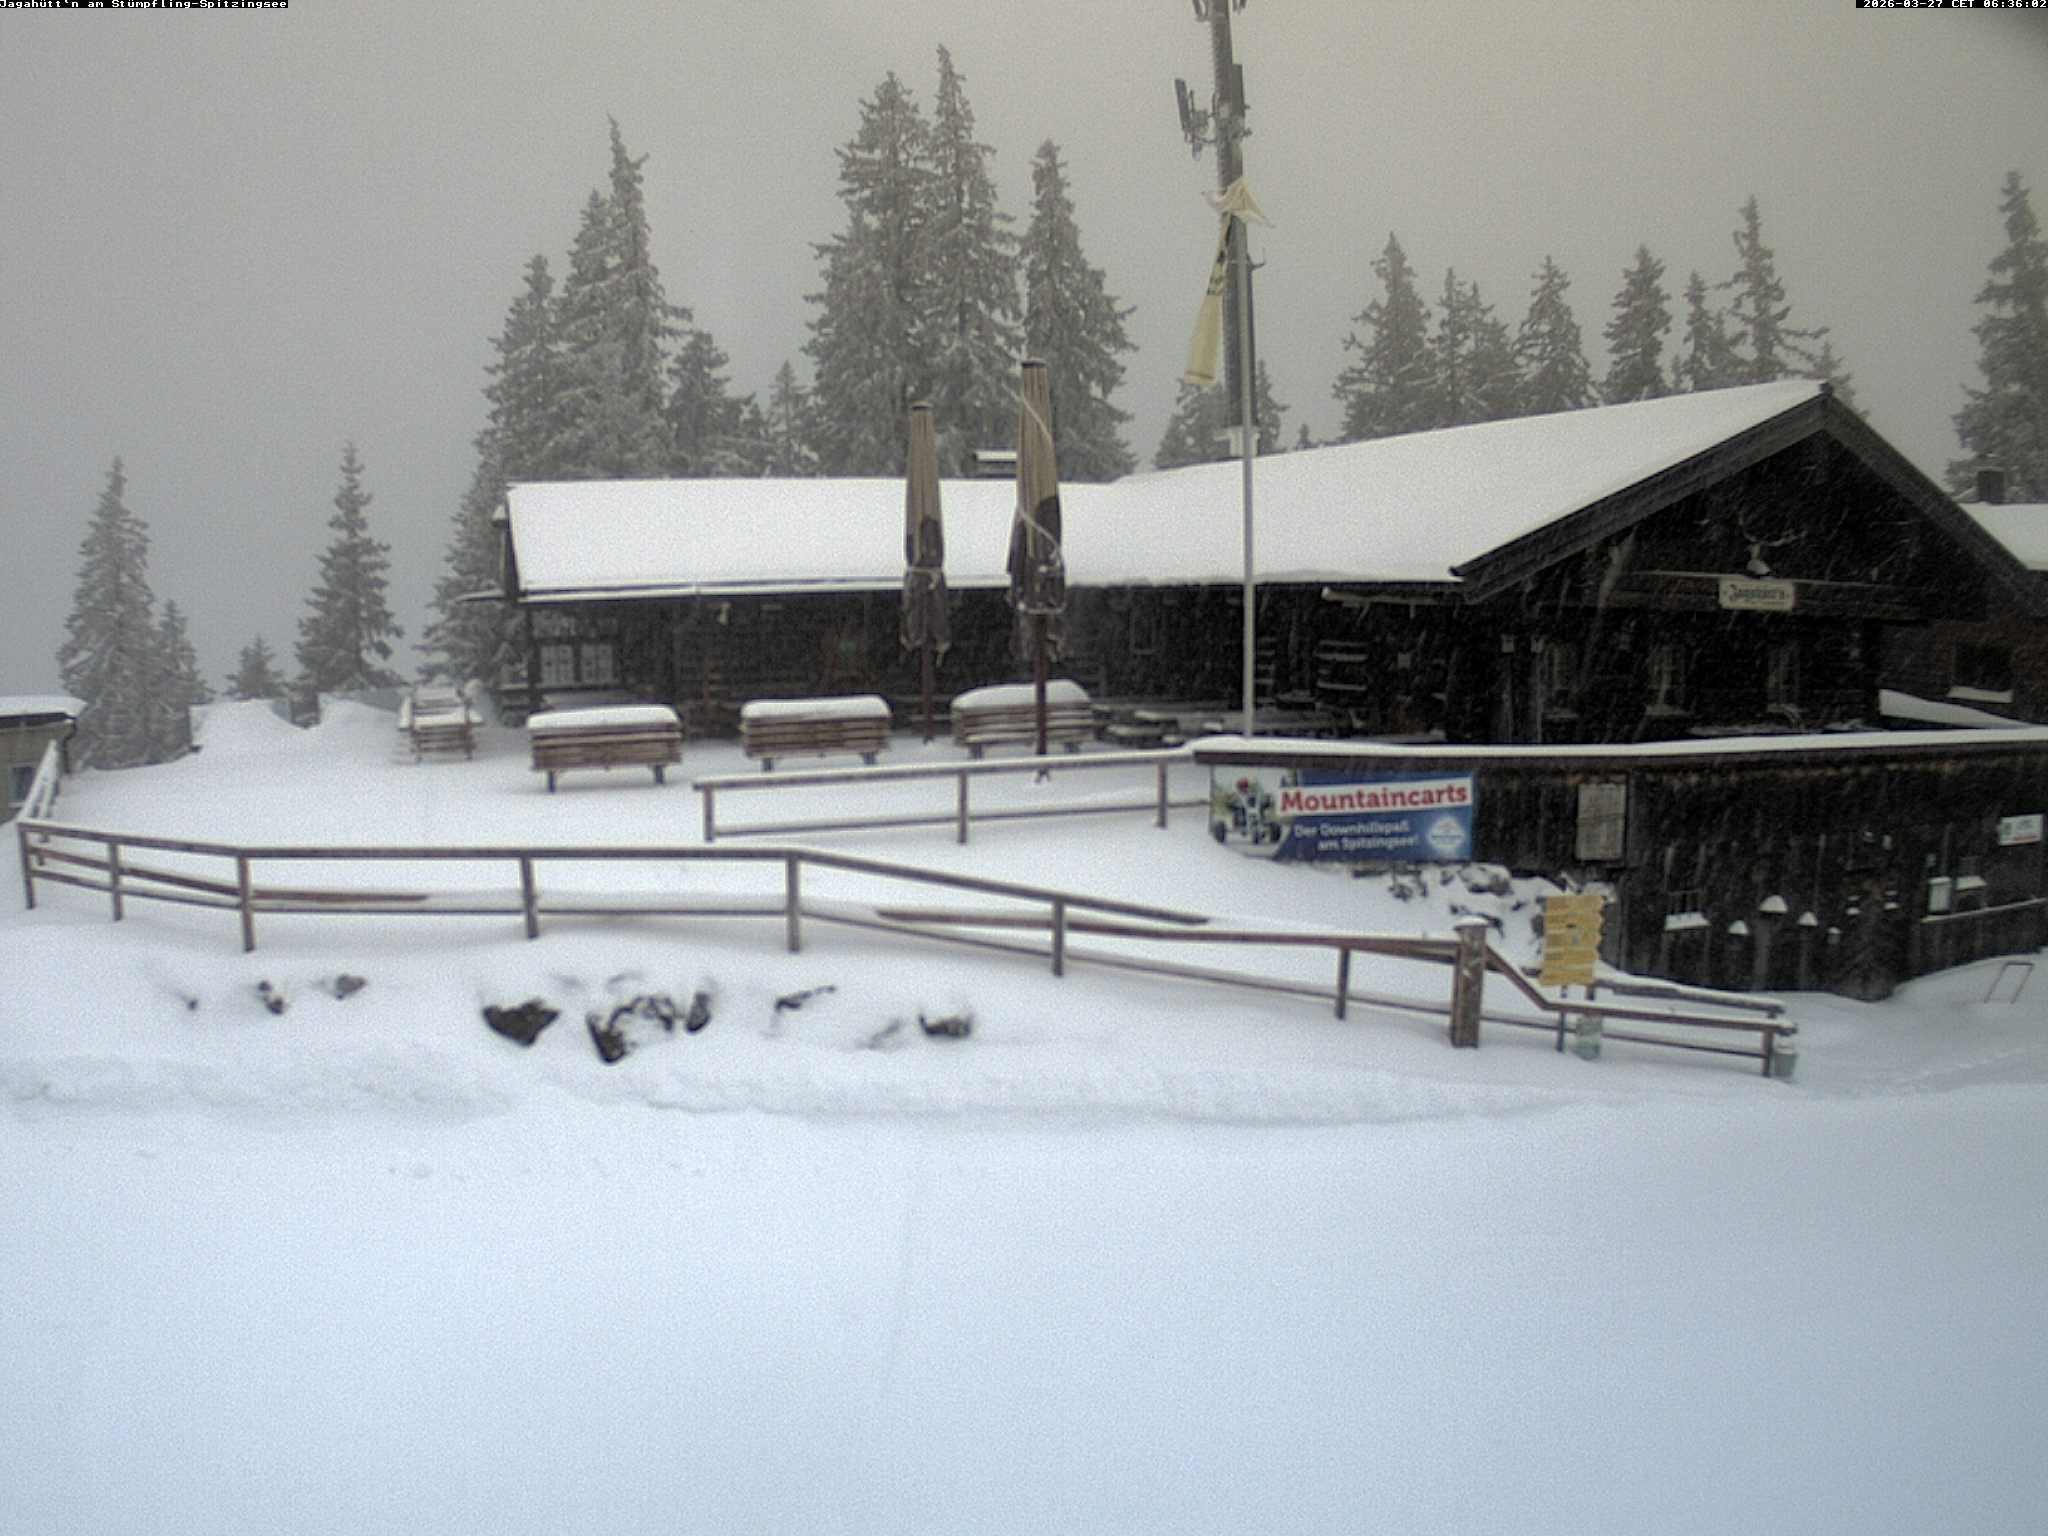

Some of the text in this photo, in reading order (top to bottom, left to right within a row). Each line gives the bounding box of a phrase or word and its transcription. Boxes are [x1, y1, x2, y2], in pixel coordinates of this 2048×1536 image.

[1281, 785, 1467, 811] Mountaincarts
[1295, 824, 1316, 837] Der
[1318, 840, 1338, 850] am
